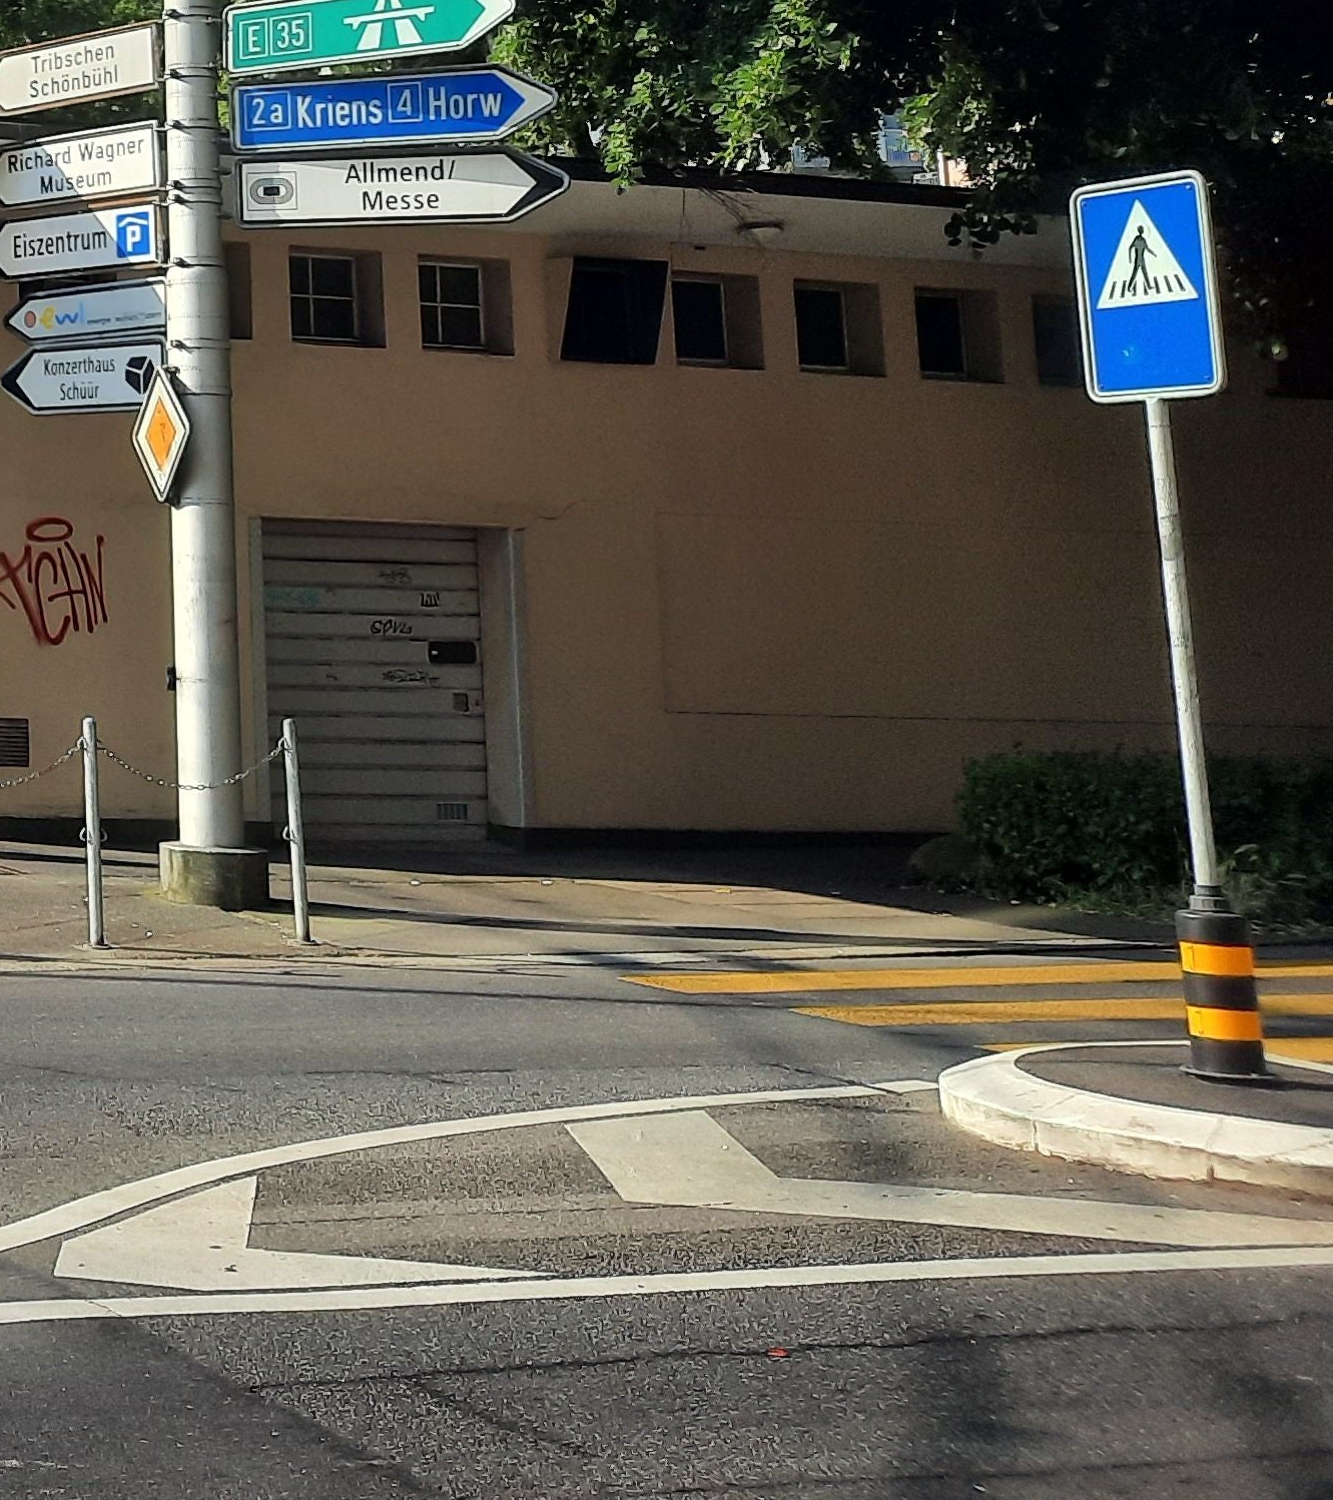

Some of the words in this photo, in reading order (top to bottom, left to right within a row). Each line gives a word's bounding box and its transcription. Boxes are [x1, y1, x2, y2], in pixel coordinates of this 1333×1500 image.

[247, 25, 262, 53] E
[276, 19, 305, 49] 35
[30, 45, 115, 74] Tribschen
[29, 64, 119, 98] Schönbühl
[251, 97, 283, 126] 2a
[296, 94, 384, 129] Kriens
[396, 88, 413, 116] 4
[428, 85, 503, 121] Horw
[7, 145, 72, 174] Richard
[78, 138, 145, 163] Wagner
[40, 170, 113, 195] Museum
[344, 158, 456, 184] Allmend/
[362, 190, 440, 211] Messe
[13, 230, 108, 259] Eiszentrum
[43, 356, 116, 377] Konzerthaus
[59, 381, 100, 401] Schüür
